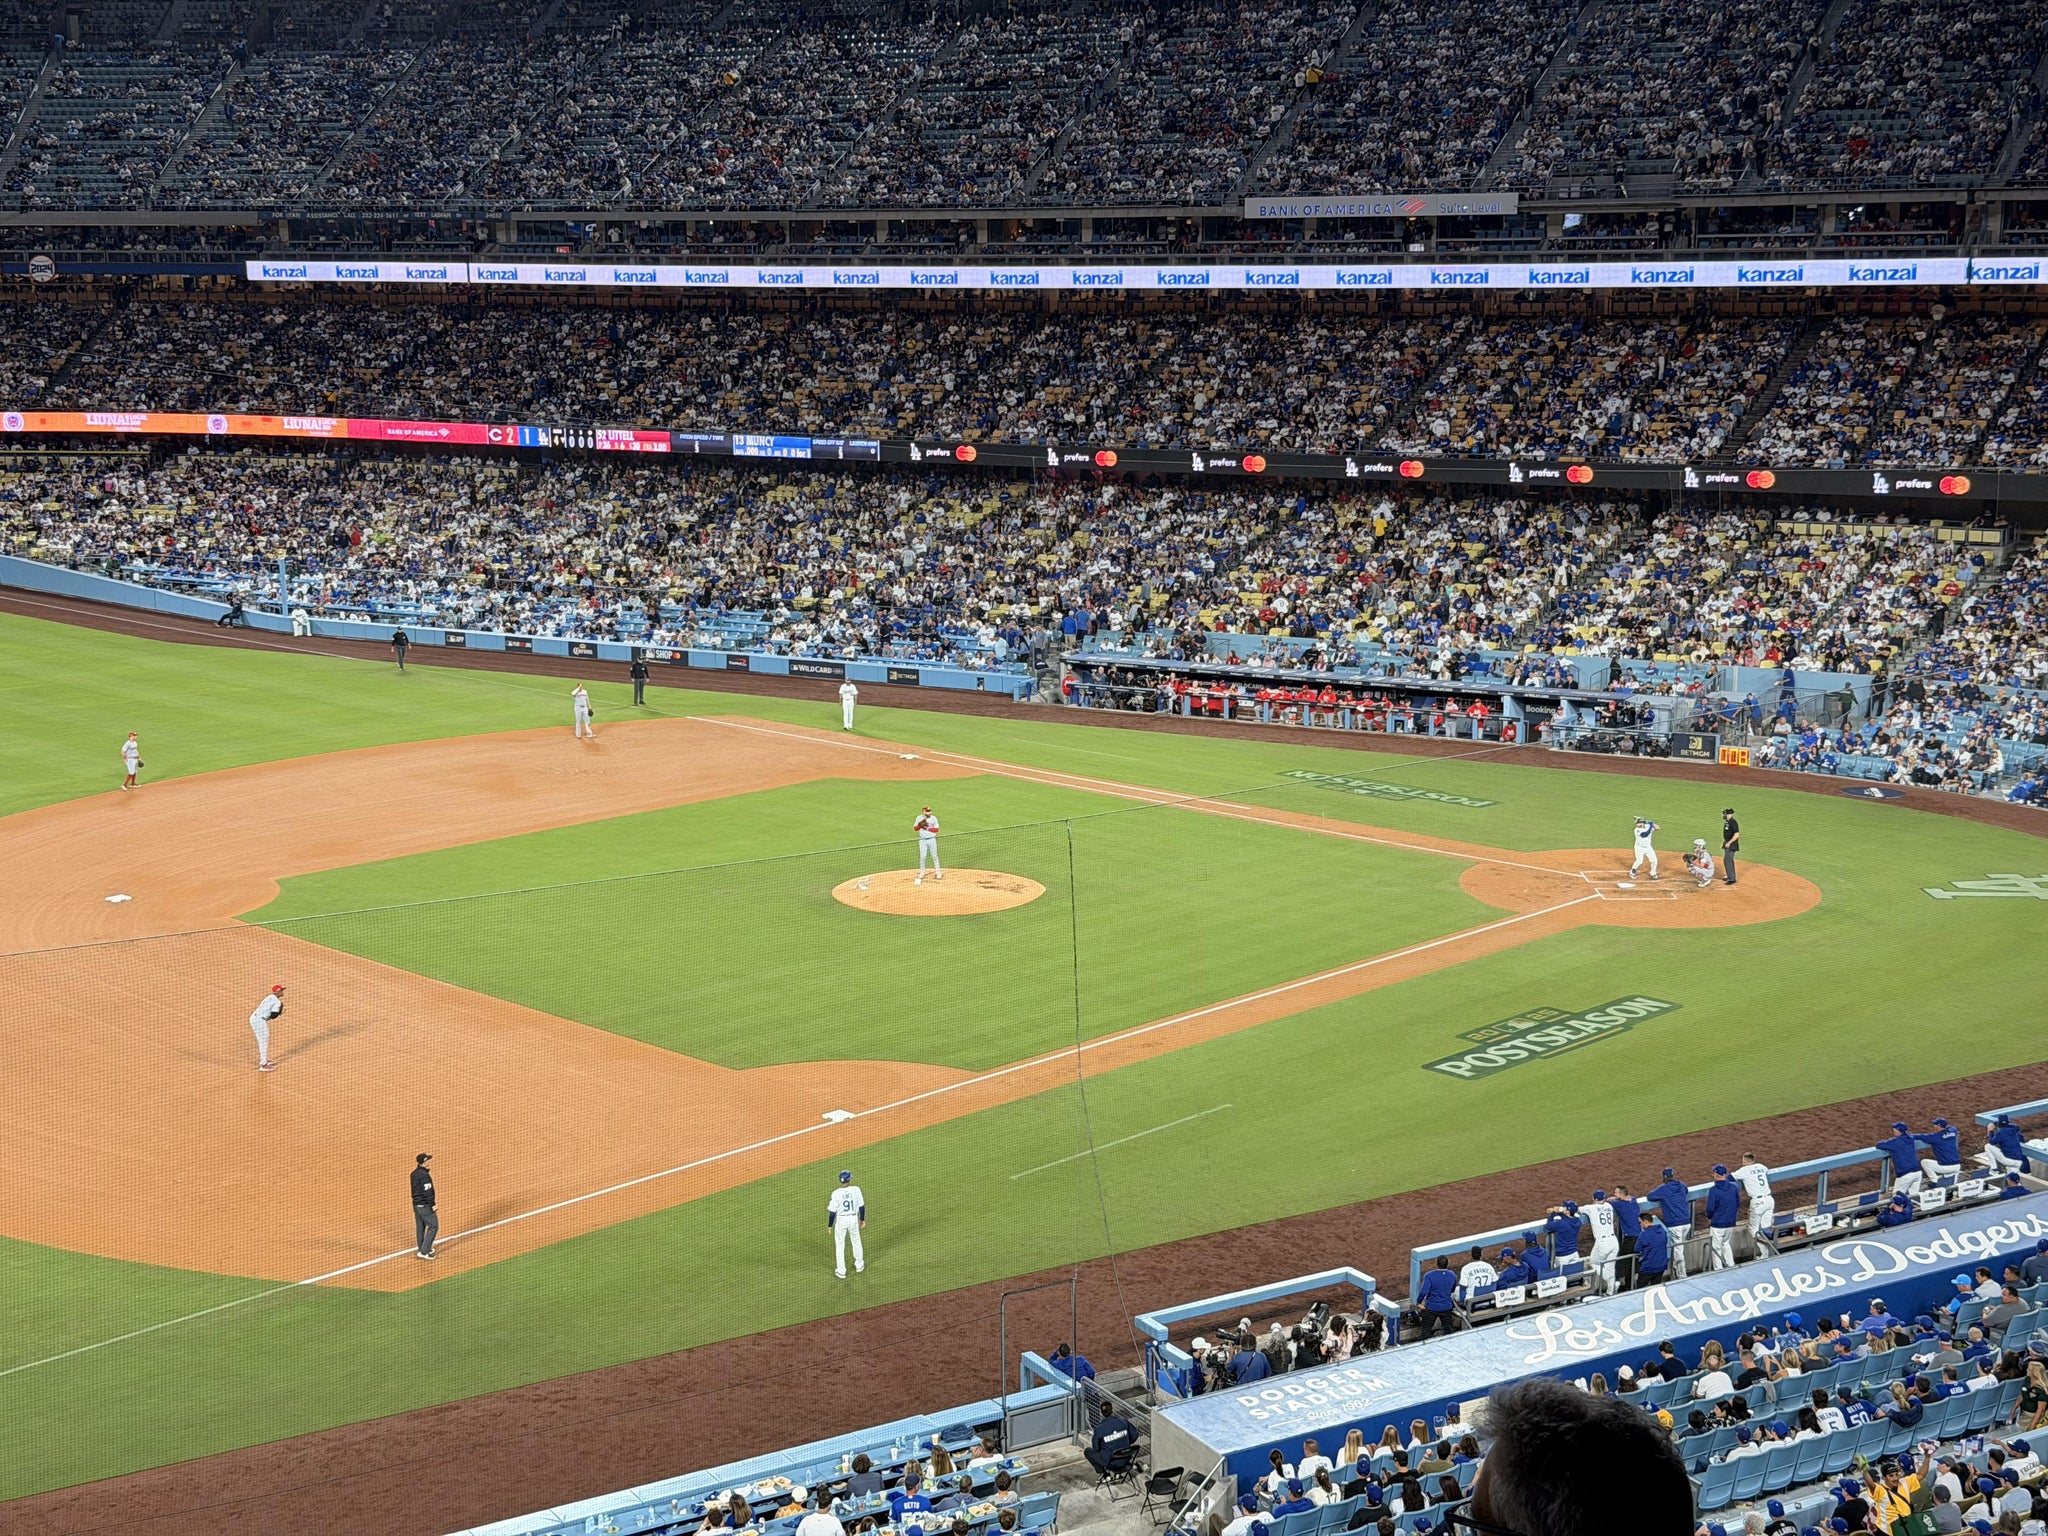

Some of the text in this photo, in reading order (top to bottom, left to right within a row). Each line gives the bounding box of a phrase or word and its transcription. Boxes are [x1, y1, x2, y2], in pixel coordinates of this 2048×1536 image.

[1259, 203, 1392, 217] BANK OF AMERICA
[1440, 201, 1502, 214] Suite Level
[30, 263, 53, 274] 2024
[488, 428, 549, 446] C 2 1 LA
[553, 435, 594, 448] 4 0 0 0
[597, 430, 634, 441] 52 LITTELL
[735, 436, 774, 447] 13 MUNCY
[910, 443, 950, 460] LA prefers
[1047, 448, 1089, 466] LA prefers
[1192, 452, 1236, 471] LA prefers
[1346, 457, 1393, 477] LA prefers
[1509, 463, 1559, 482] LA prefers
[1684, 467, 1739, 488] LA prefers
[1873, 473, 1932, 494] LA prefers
[572, 646, 593, 656] Corona
[655, 650, 673, 659] SHOP
[1525, 705, 1556, 715] Booking
[1680, 749, 1710, 758] BETMGM
[1285, 770, 1493, 808] POSTSEASON
[1466, 1008, 1560, 1041] 20 25
[1434, 996, 1673, 1078] POSTSEASON
[1757, 1174, 1765, 1187] 5
[842, 1200, 854, 1212] 91
[1599, 1212, 1612, 1225] 68
[1474, 1275, 1489, 1288] 37
[1505, 1213, 2048, 1364] Los Angeles Dodgers
[1236, 1367, 1366, 1408] DODGER
[1248, 1375, 1392, 1421] STADIUM
[1306, 1397, 1373, 1421] Since 1962
[1846, 1402, 1863, 1415] BETTS
[1828, 1420, 1838, 1431] 5
[1850, 1411, 1871, 1426] 50
[1326, 1493, 1338, 1505] 17
